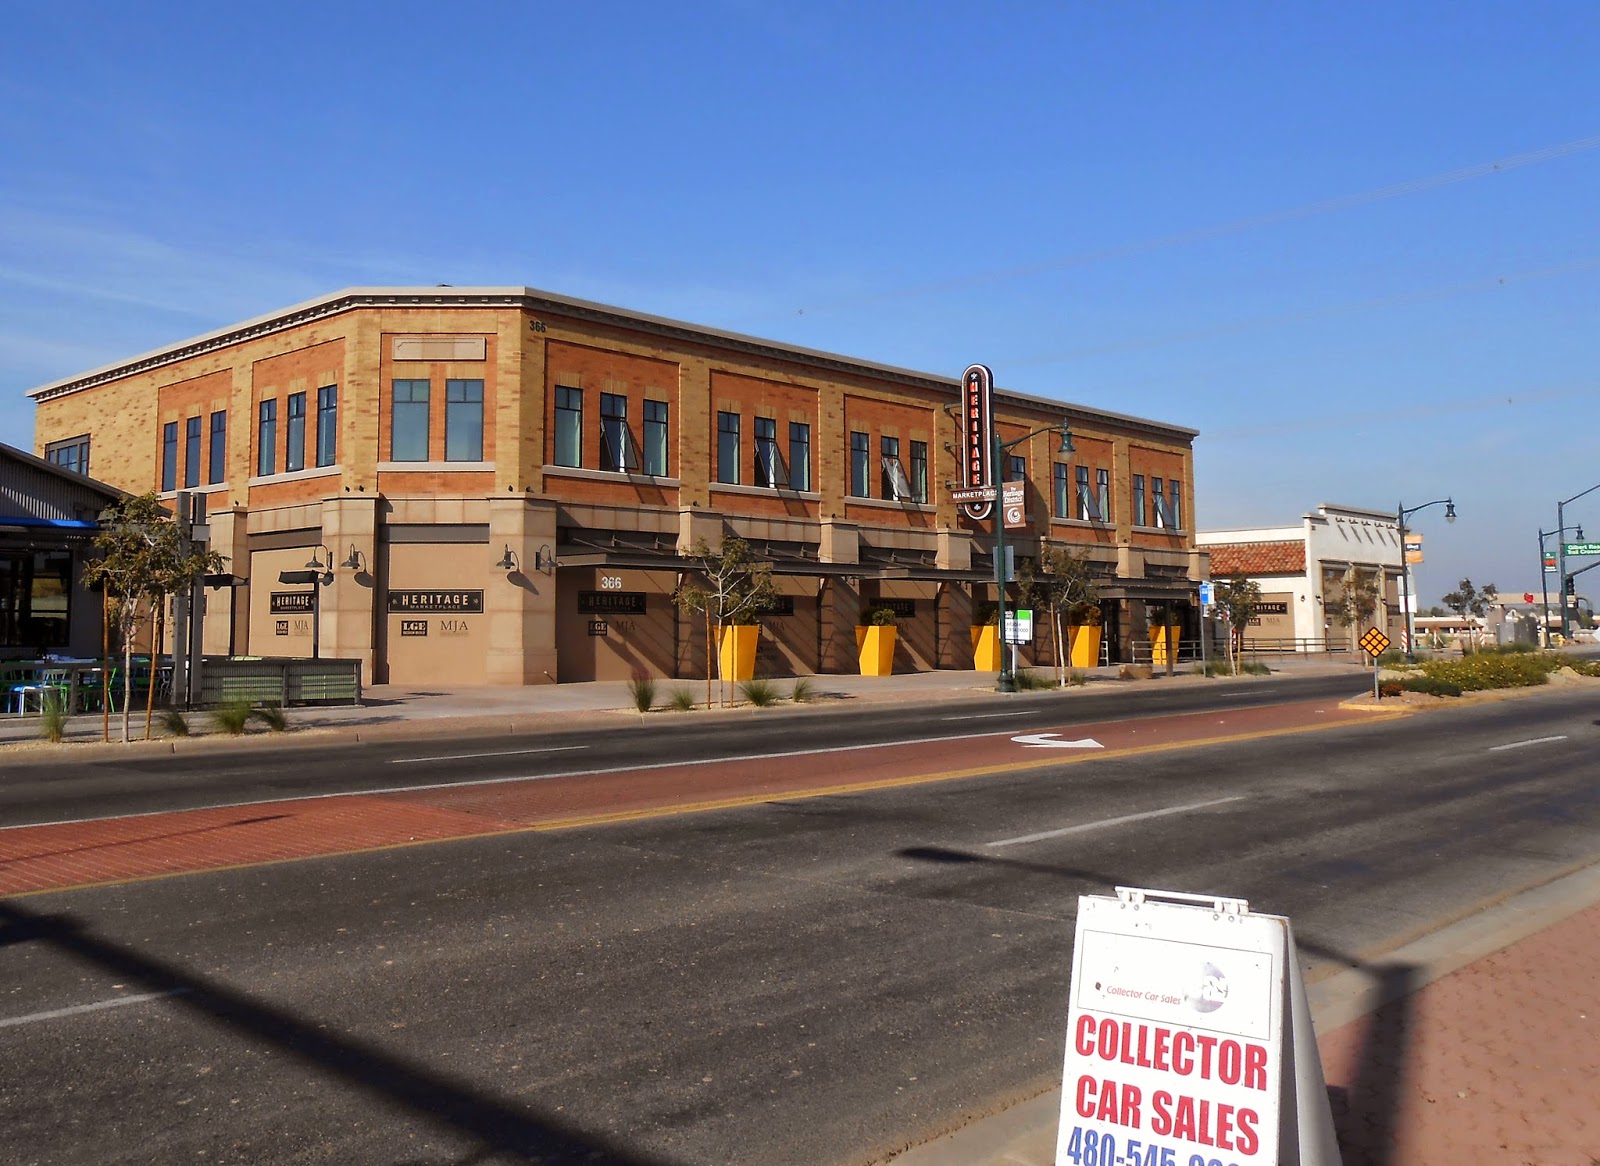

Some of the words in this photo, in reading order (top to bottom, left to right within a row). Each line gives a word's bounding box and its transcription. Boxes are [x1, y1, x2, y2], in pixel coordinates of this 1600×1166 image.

[529, 320, 547, 333] 366
[970, 382, 980, 485] HERITAGE
[601, 576, 622, 589] 366
[276, 596, 309, 606] HERITAGE
[402, 594, 469, 606] HERITAGE
[588, 596, 636, 607] HERITAGE
[294, 620, 309, 632] MJA
[402, 622, 426, 631] LGE
[440, 620, 469, 633] MJA
[1106, 985, 1143, 999] Collector
[1144, 991, 1160, 1002] Car
[1160, 994, 1182, 1006] Sales
[1075, 1014, 1268, 1092] COLLECTOR
[1075, 1074, 1142, 1130] CAR
[1150, 1089, 1260, 1156] SALES
